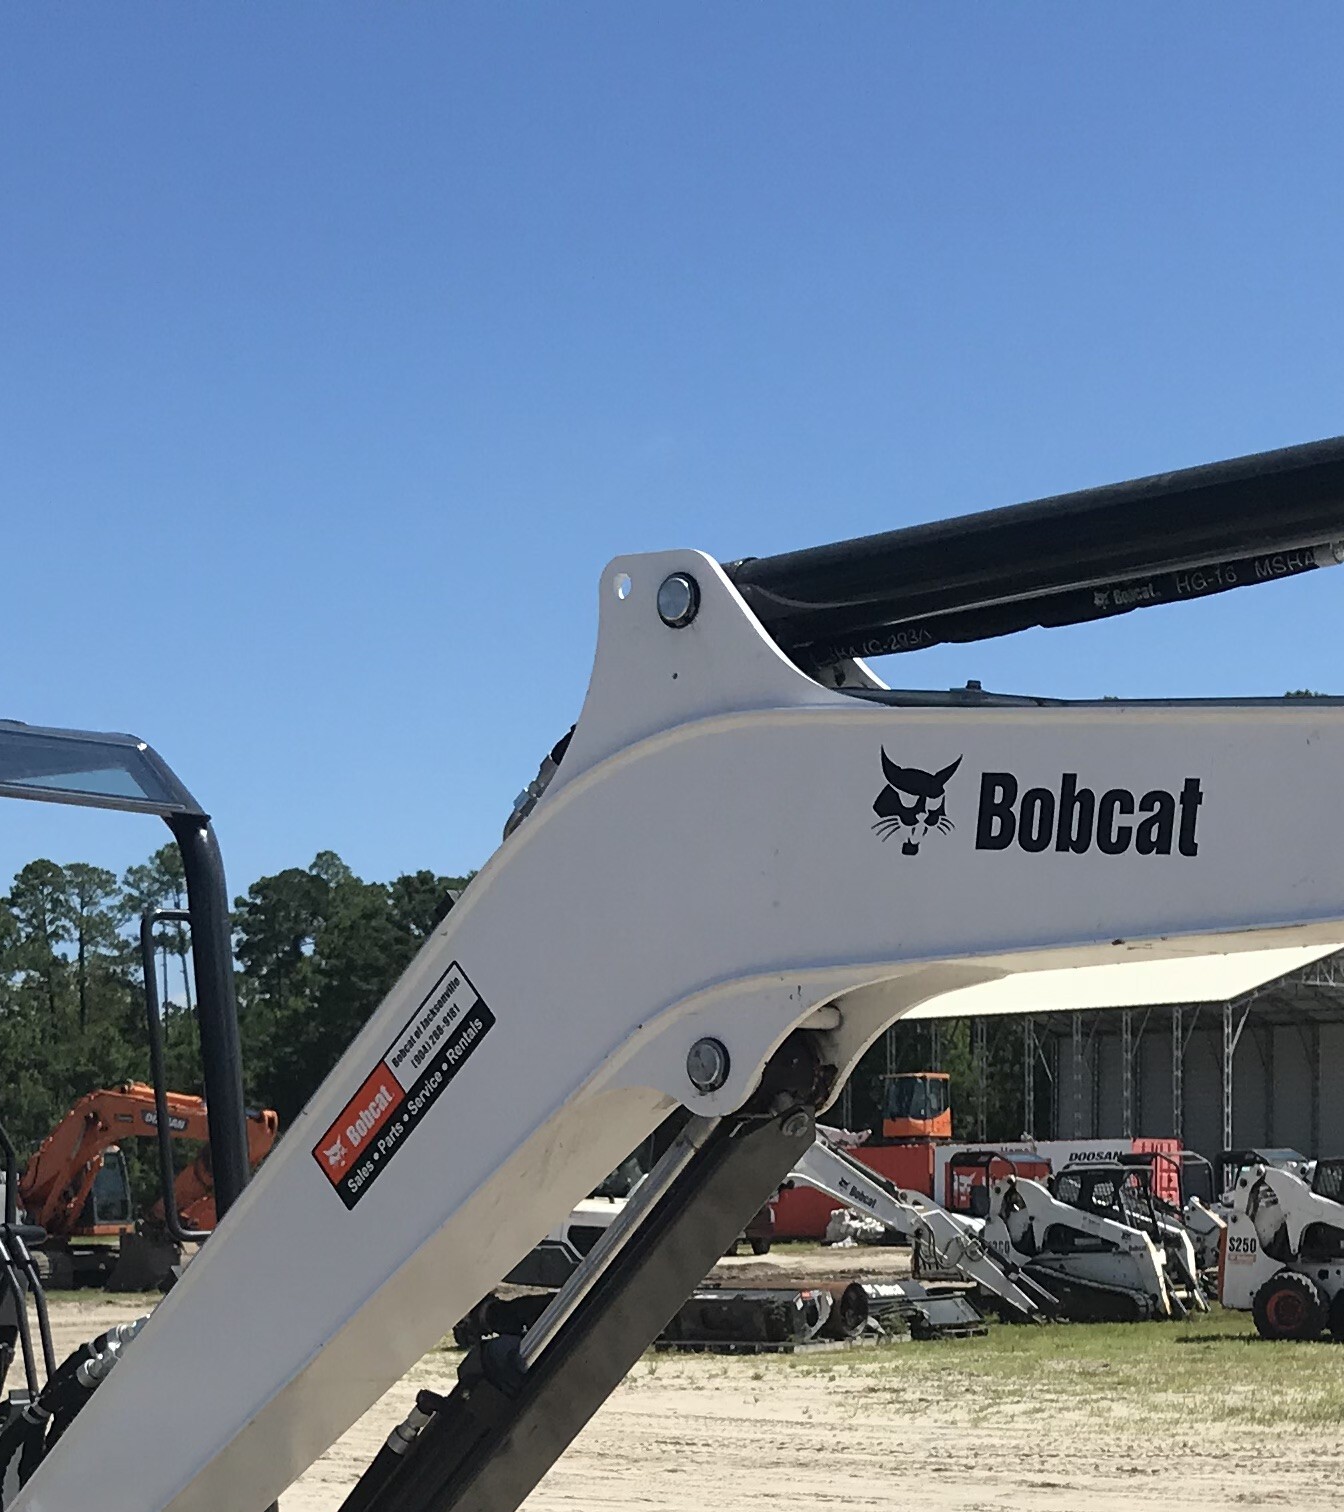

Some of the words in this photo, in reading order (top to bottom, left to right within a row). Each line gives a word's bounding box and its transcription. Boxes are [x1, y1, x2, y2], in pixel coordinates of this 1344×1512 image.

[1176, 566, 1237, 594] HG-16
[1255, 551, 1316, 578] MSHA
[975, 772, 1203, 857] Bobcat
[391, 1035, 417, 1068] Bobcat
[419, 977, 461, 1031] Jacksonville
[345, 1084, 394, 1147] Bobcat
[347, 1159, 375, 1193] Sales
[377, 1122, 404, 1155] Parts
[407, 1069, 443, 1116] Service
[446, 1017, 483, 1065] Rentals
[1069, 1151, 1123, 1162] DOOSAN
[1228, 1236, 1257, 1254] S250
